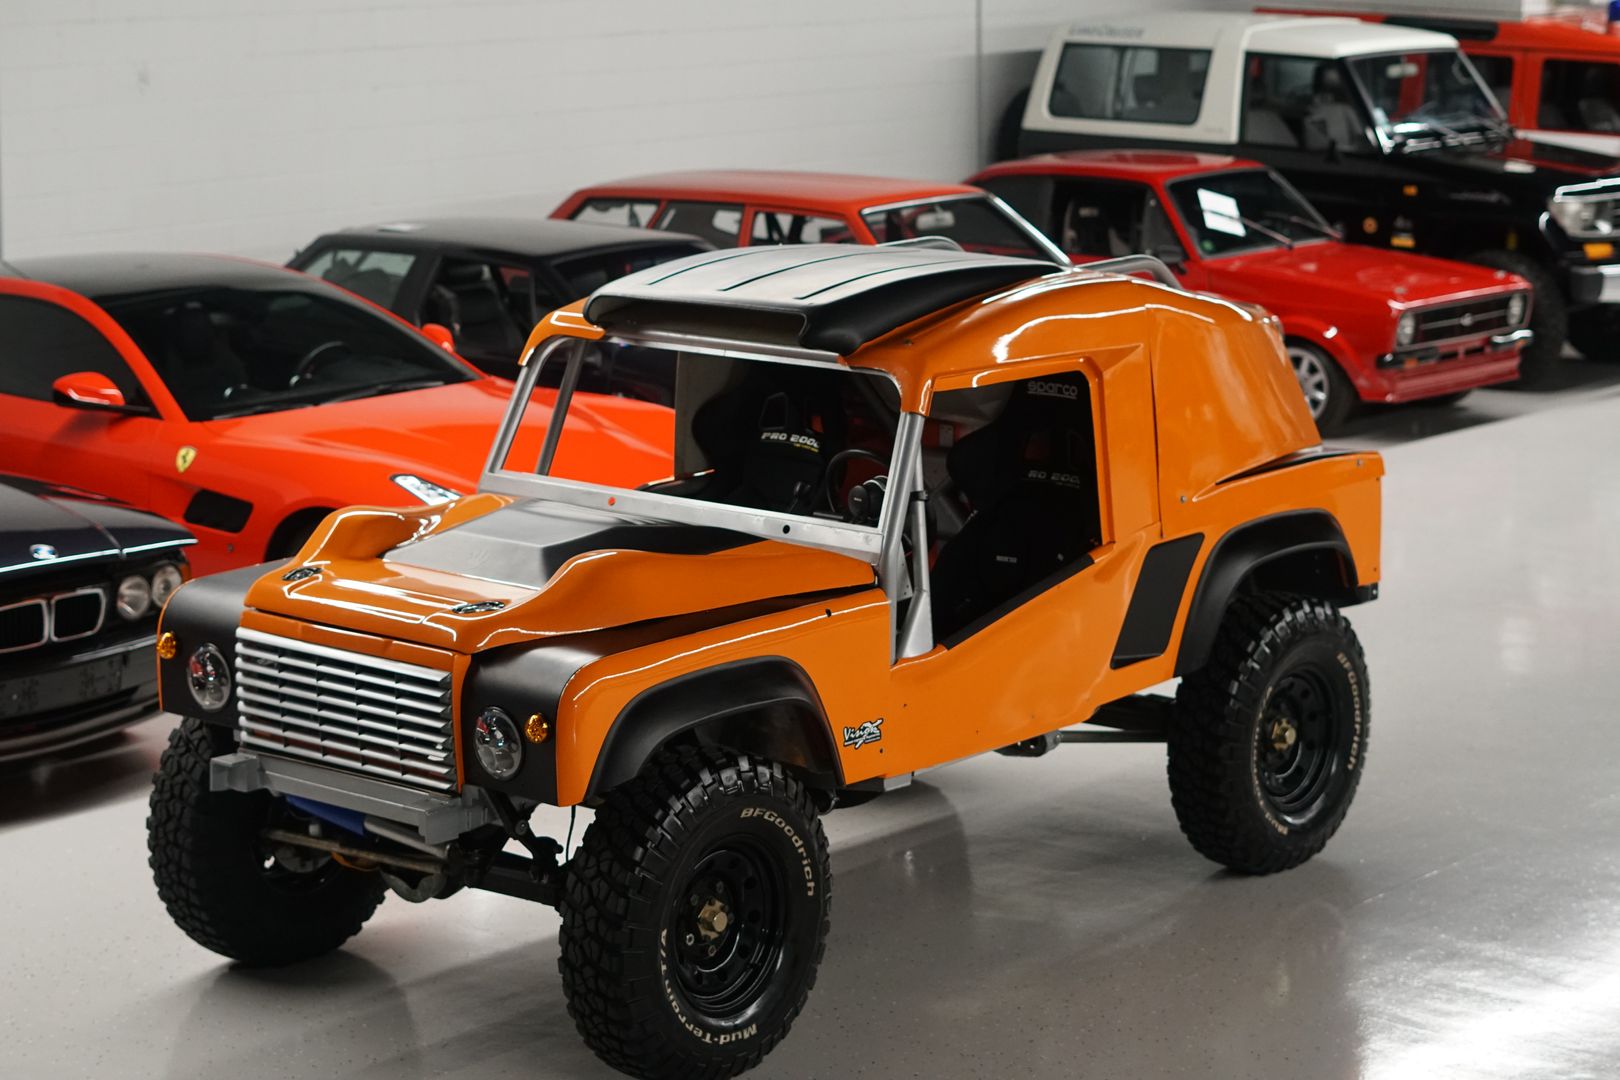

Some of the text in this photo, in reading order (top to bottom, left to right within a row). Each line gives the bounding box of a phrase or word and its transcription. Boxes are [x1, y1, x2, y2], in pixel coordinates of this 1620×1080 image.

[1027, 381, 1078, 397] sparco
[761, 432, 788, 440] PRO
[1337, 651, 1361, 770] BFGoodrich
[740, 807, 815, 897] BFGoodrich
